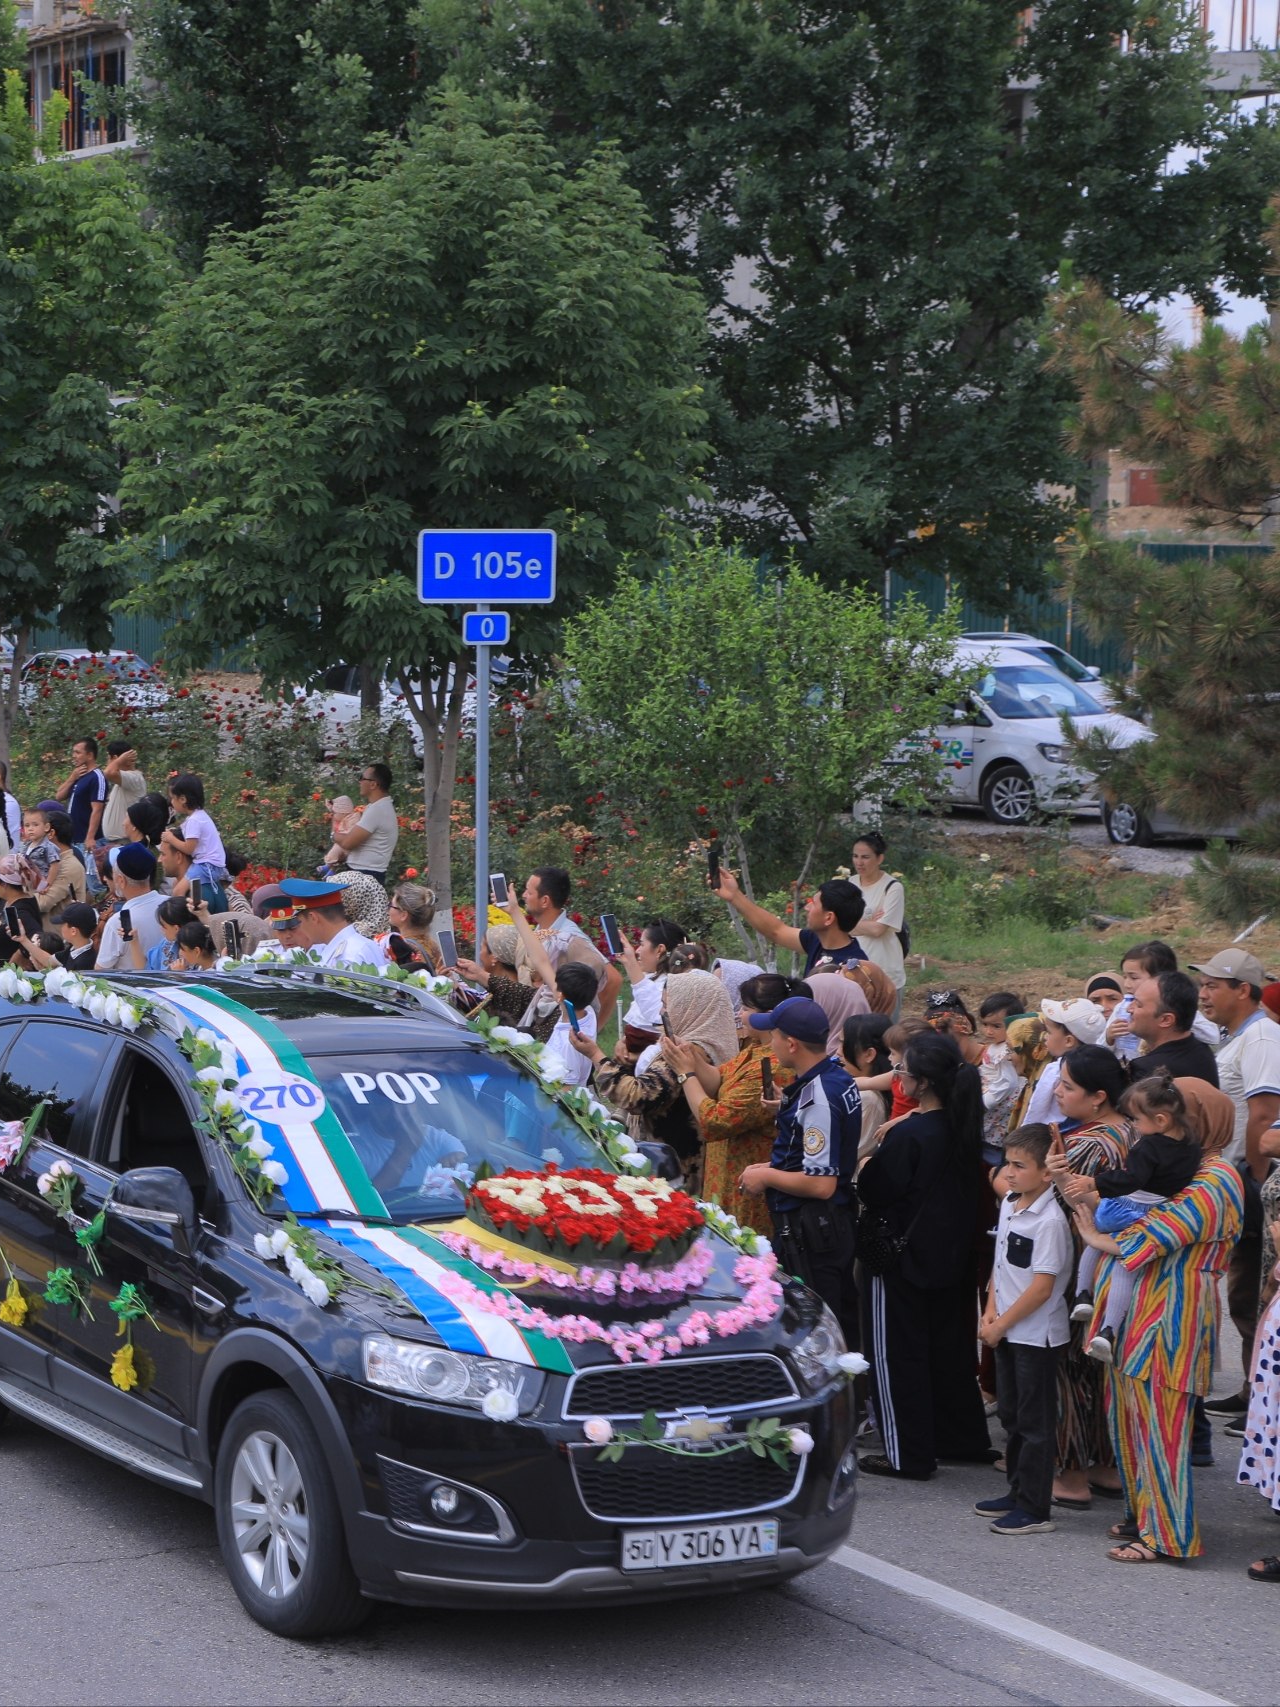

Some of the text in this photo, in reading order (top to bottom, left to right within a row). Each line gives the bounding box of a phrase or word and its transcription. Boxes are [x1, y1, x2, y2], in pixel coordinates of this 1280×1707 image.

[434, 551, 542, 579] D 105e
[480, 617, 494, 638] 0
[242, 1083, 317, 1111] 270
[340, 1071, 442, 1105] POP
[660, 1533, 677, 1561] Y
[681, 1530, 725, 1560] 306
[730, 1525, 762, 1554] YA
